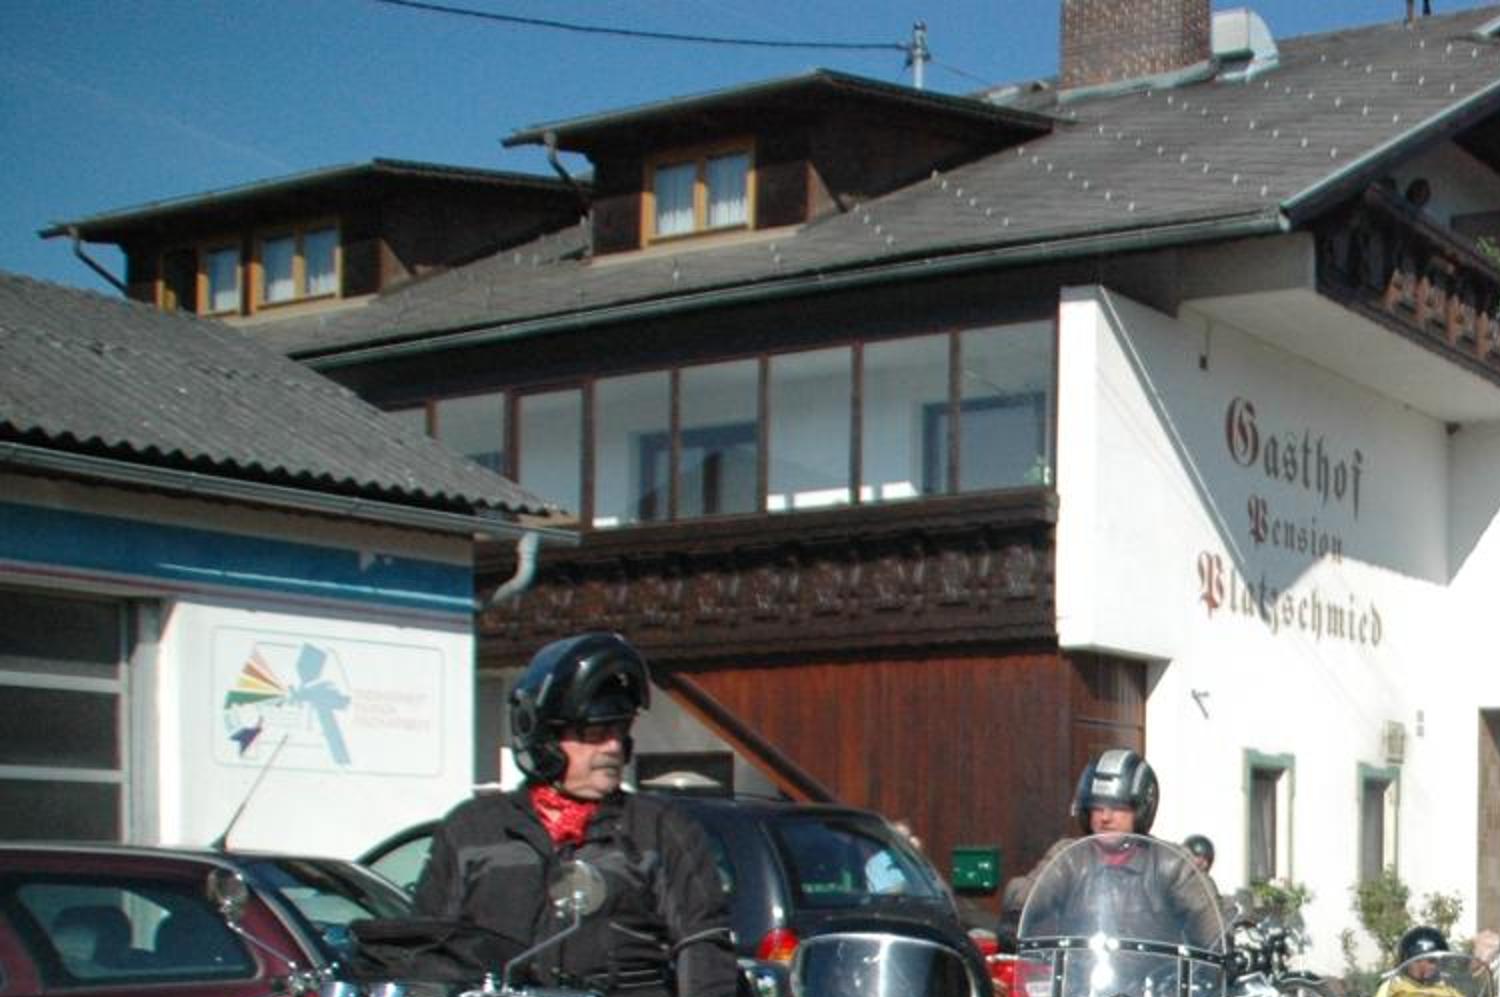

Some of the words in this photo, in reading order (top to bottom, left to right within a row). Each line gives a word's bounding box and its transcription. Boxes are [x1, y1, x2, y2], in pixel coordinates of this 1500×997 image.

[1226, 396, 1363, 523] Gasthof
[1248, 496, 1343, 564] Pension
[1198, 551, 1382, 646] Platzschmied
